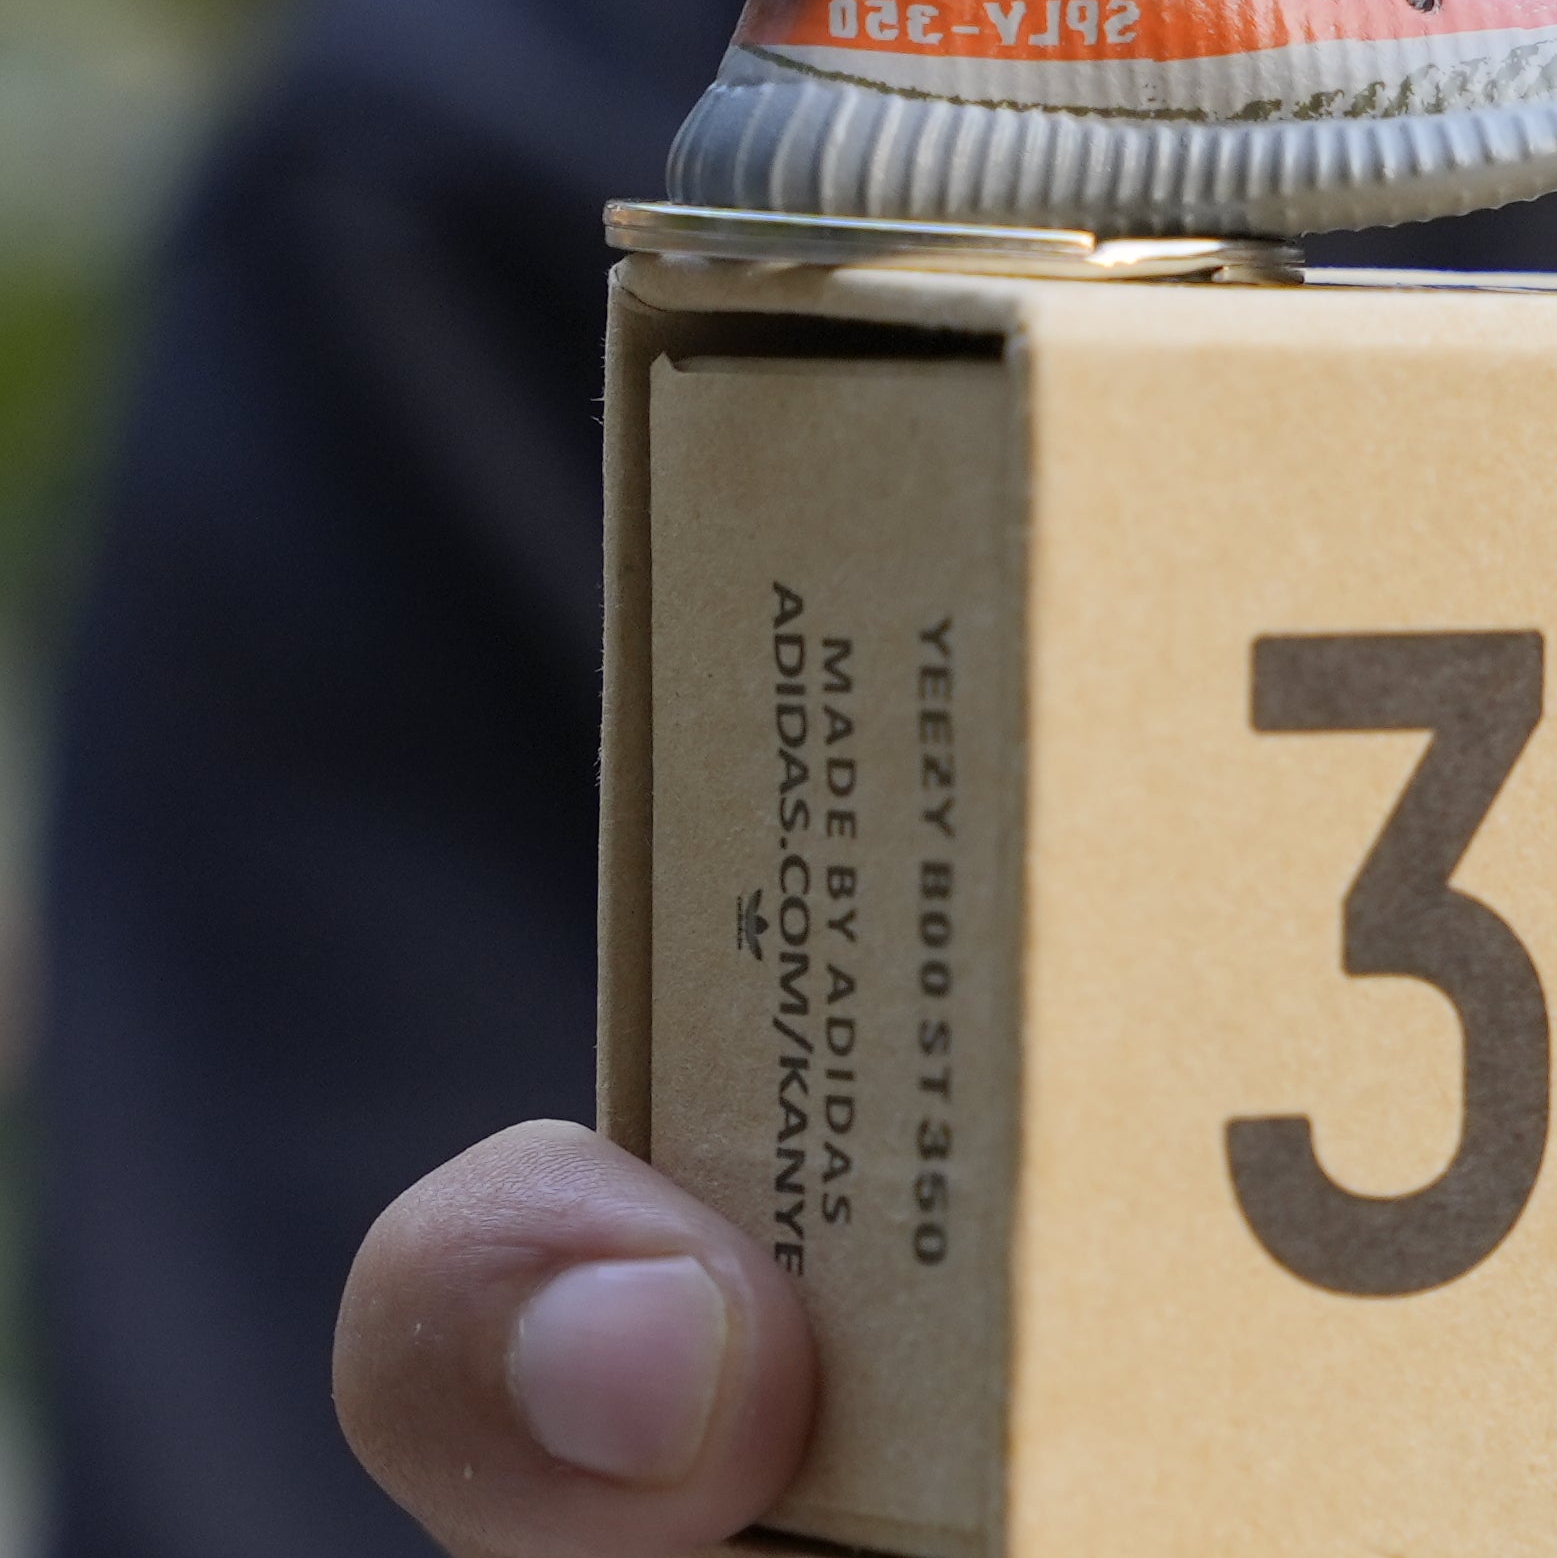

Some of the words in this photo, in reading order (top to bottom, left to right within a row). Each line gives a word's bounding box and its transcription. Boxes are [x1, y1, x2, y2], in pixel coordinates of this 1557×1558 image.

[822, 637, 858, 840] MADE
[918, 616, 955, 838] YEEZY
[773, 580, 814, 1277] ADIDAS.COM/KANYE
[826, 865, 858, 943] BY
[822, 962, 857, 1226] ADIDAS
[913, 1118, 952, 1266] 350
